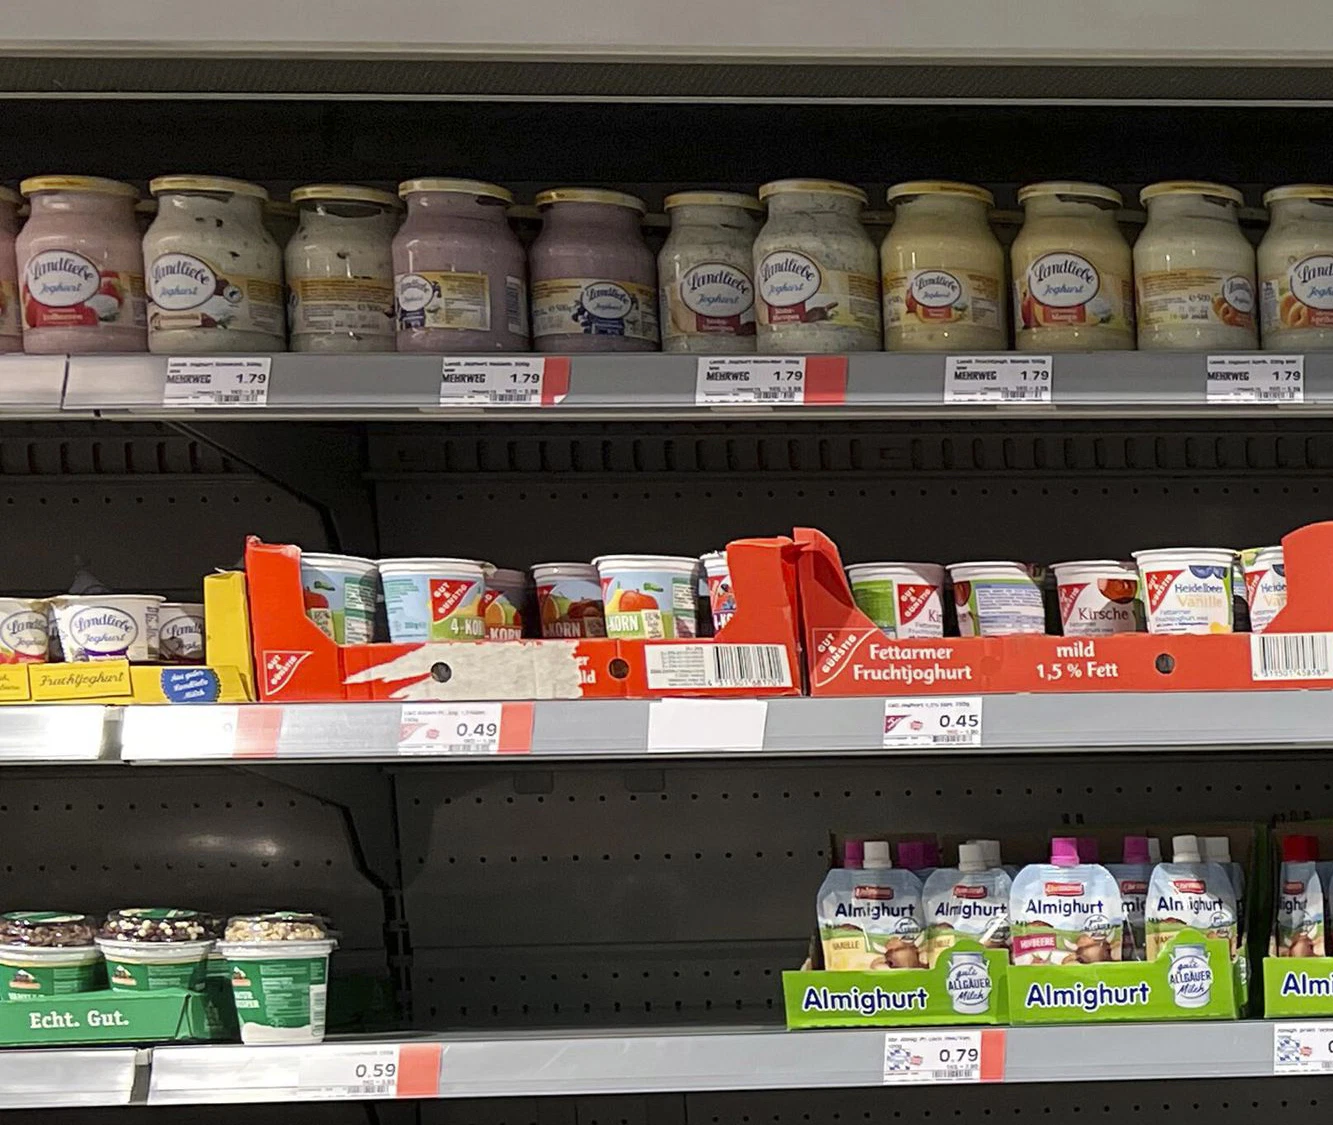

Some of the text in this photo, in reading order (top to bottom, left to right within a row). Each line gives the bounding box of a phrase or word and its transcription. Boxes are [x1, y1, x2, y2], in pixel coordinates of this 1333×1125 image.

[772, 370, 804, 382] 1.79
[1020, 370, 1050, 382] 1.79
[1272, 370, 1302, 382] 1.79
[74, 608, 136, 632] Landliebe
[1078, 607, 1129, 622] Kirsche
[816, 631, 836, 652] GUT
[1056, 640, 1096, 659] mild
[869, 643, 954, 662] Fettarmer
[853, 662, 973, 685] Fruchtjoghurt
[1036, 661, 1119, 681] 1,5 % Fett
[456, 723, 498, 737] 0.49
[938, 714, 979, 729] 0.45
[803, 984, 929, 1016] Almighurt
[29, 1009, 129, 1031] Echt. Gut.
[939, 1048, 979, 1063] 0.79
[355, 1063, 396, 1078] 0.59
